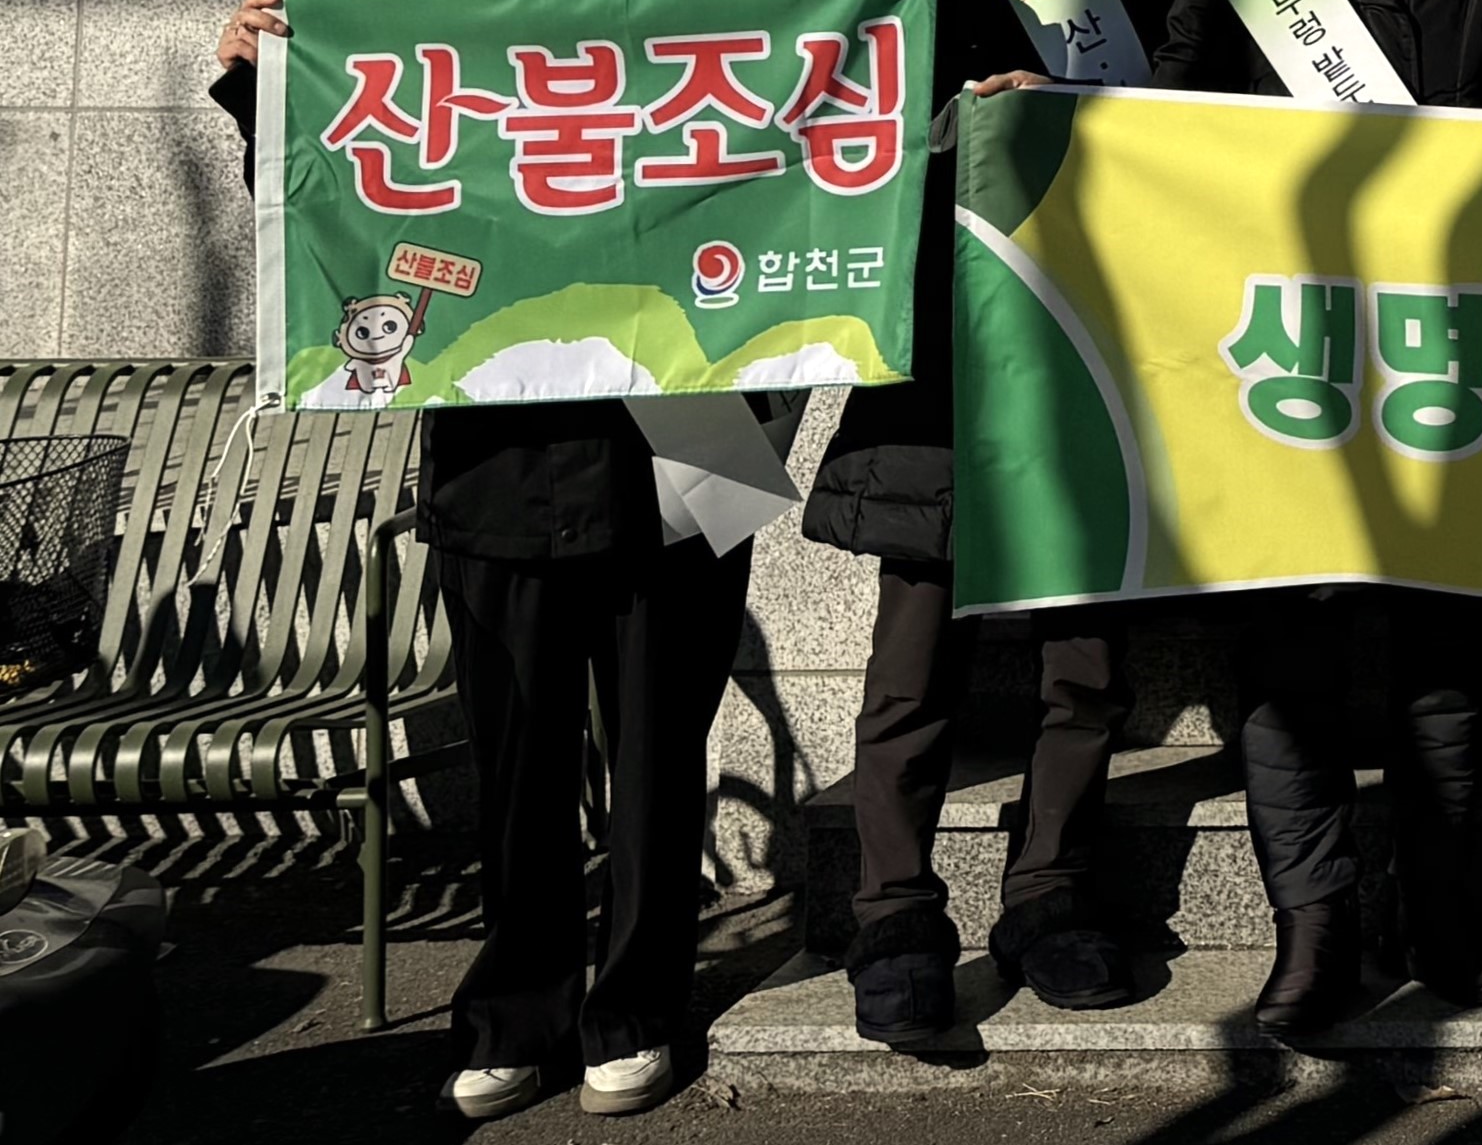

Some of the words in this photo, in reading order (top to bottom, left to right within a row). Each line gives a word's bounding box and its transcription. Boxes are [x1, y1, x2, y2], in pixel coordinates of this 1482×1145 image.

[1312, 46, 1375, 104] 밭두
[323, 17, 904, 213] 산불조심
[395, 251, 475, 291] 산불조심
[757, 246, 884, 293] 합천군
